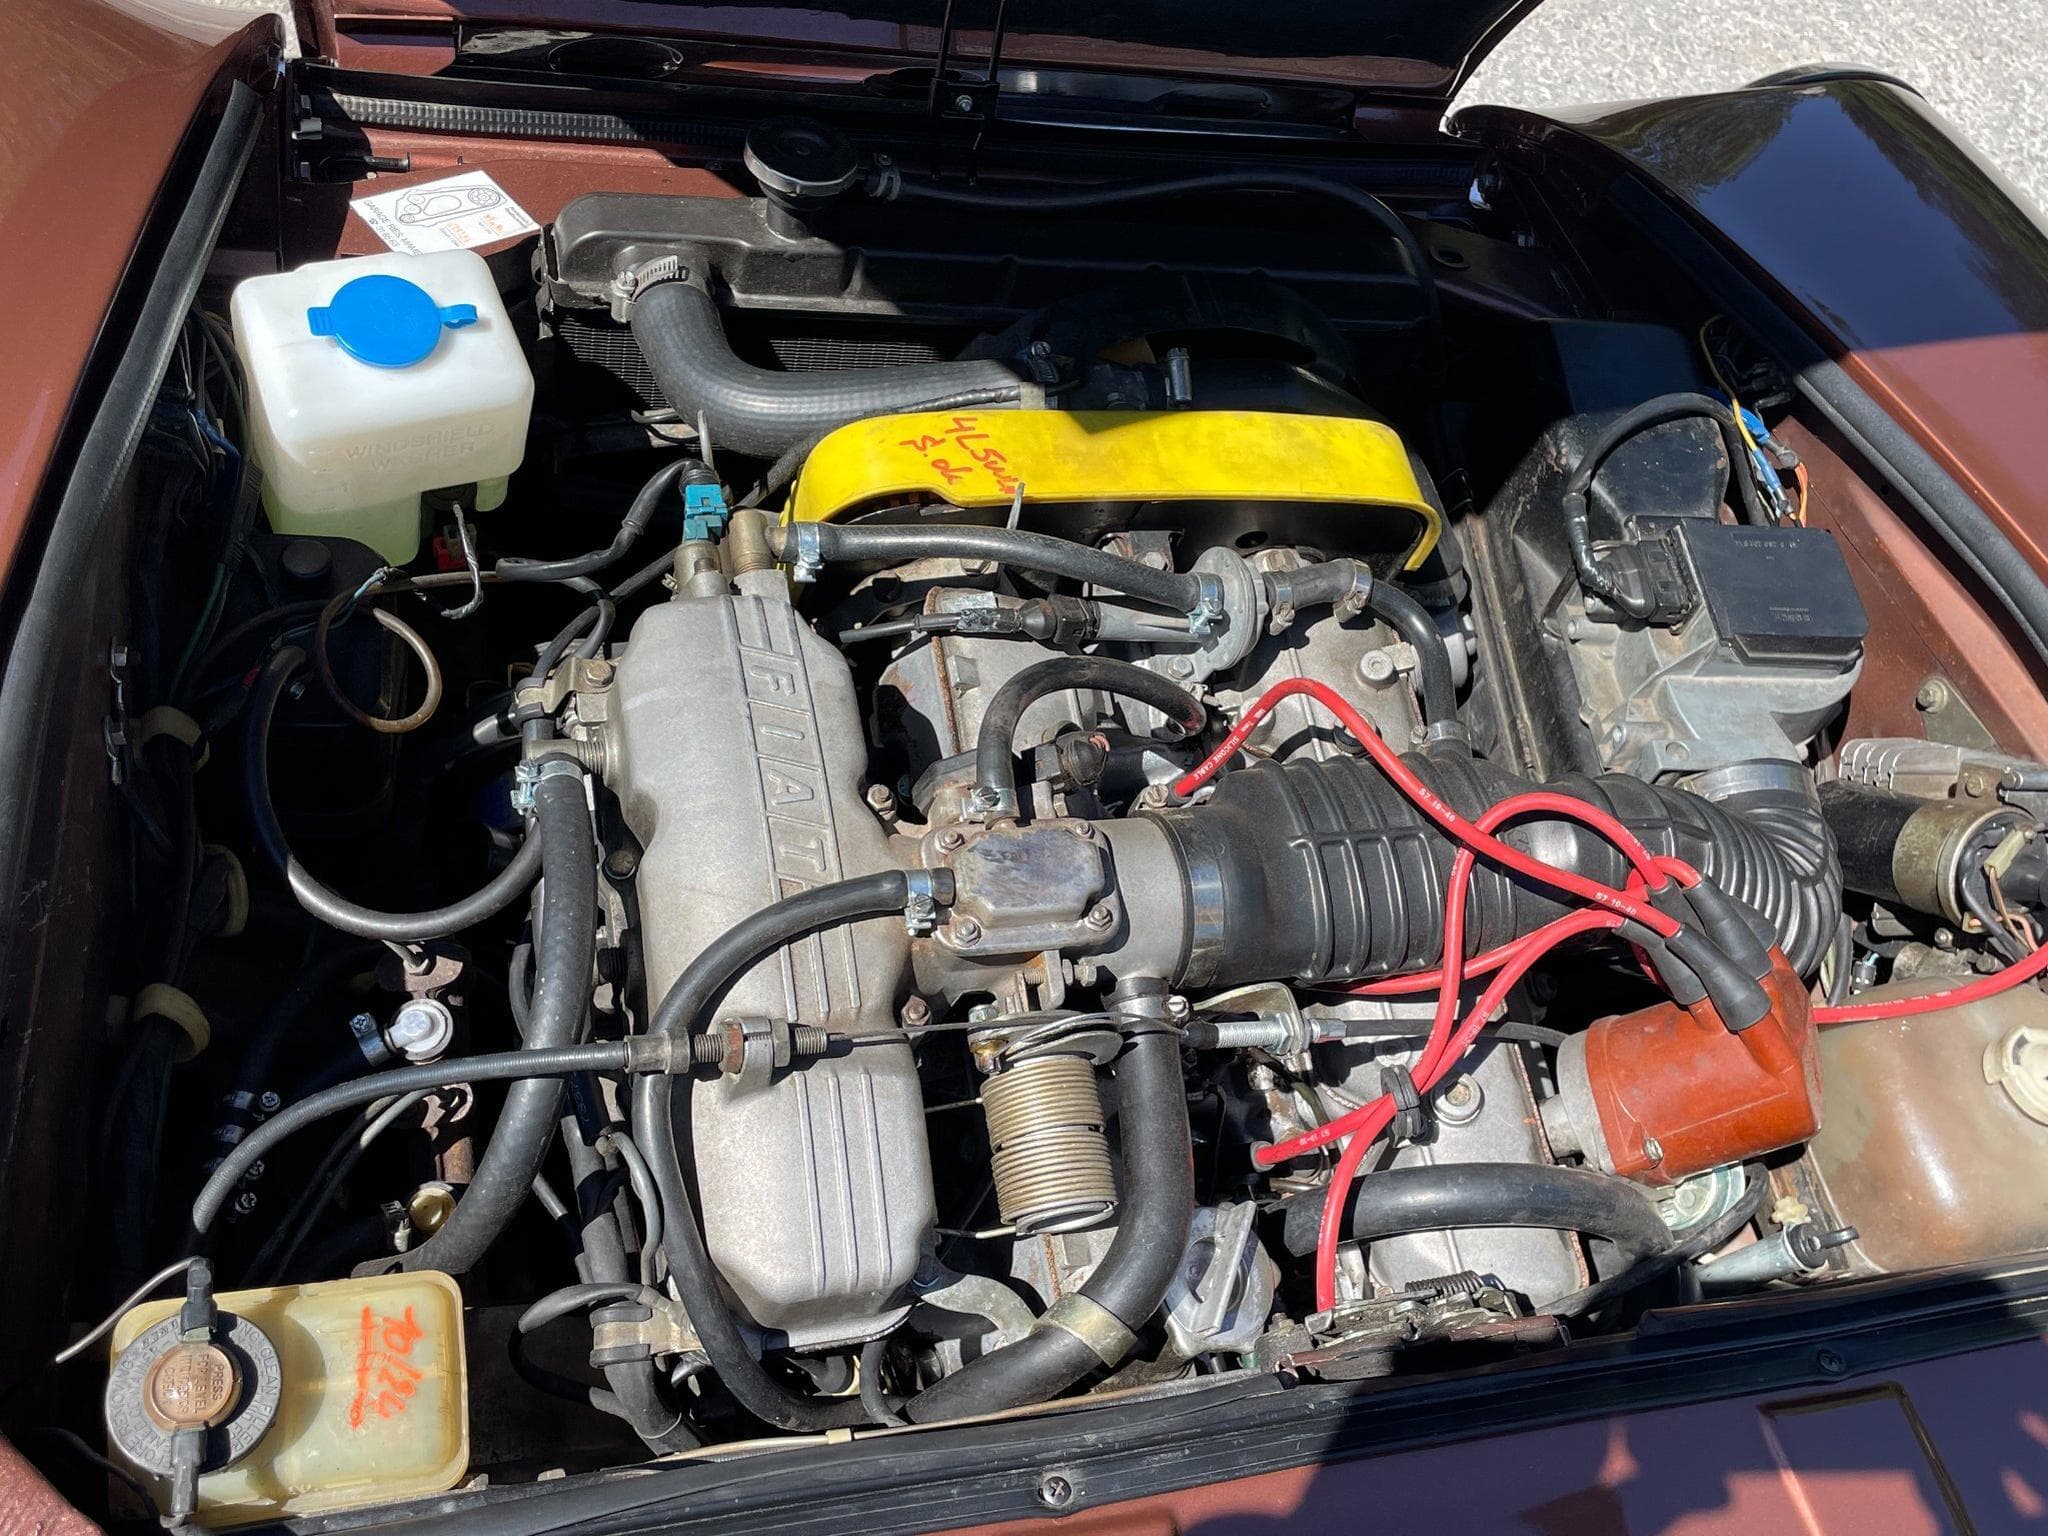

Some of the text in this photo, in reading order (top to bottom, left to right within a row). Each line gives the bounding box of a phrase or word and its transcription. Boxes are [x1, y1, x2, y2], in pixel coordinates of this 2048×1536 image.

[345, 422, 495, 462] WINDSHIELD
[749, 663, 827, 874] FIAT
[1212, 735, 1240, 764] SILICONE
[1192, 761, 1214, 781] CABLE
[211, 1362, 226, 1401] PRESS
[259, 1346, 279, 1398] CLEAN
[230, 1401, 274, 1451] FILLER
